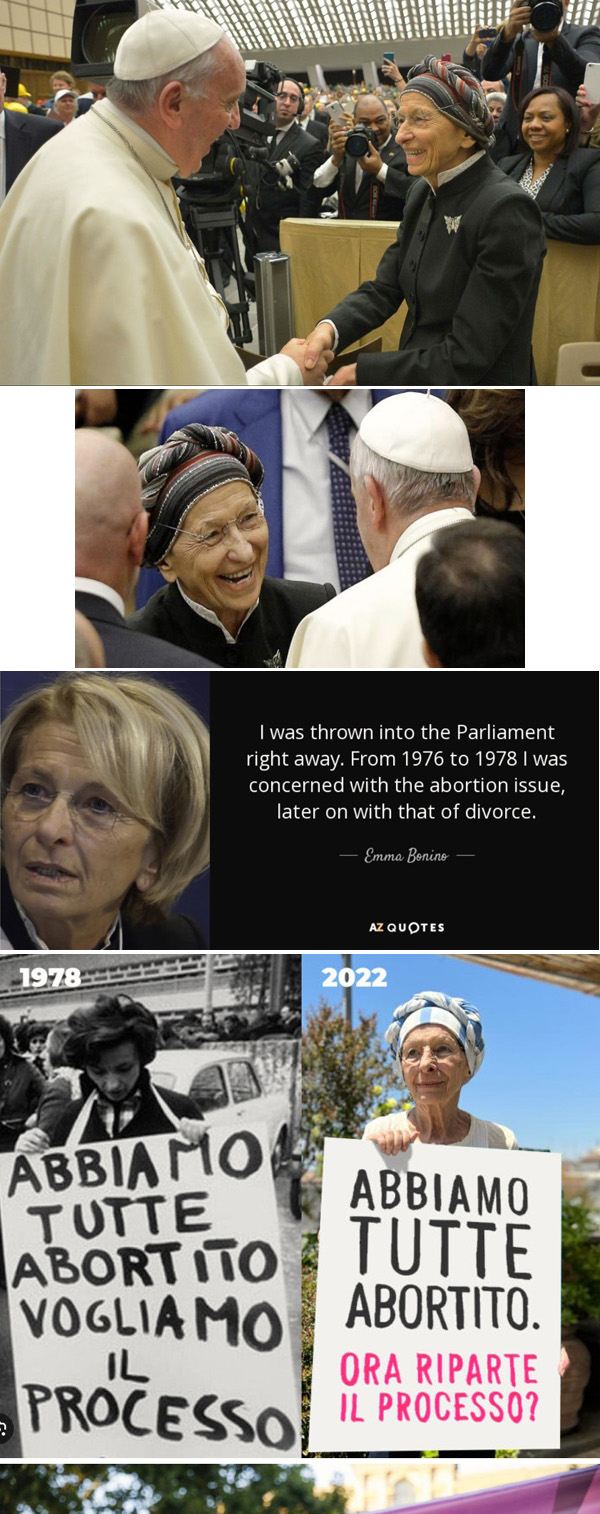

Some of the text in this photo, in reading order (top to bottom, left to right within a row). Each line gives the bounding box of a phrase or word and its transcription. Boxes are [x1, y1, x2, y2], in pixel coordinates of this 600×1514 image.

[8, 1130, 264, 1198] ABBIAMO
[26, 1192, 213, 1244] TUTTE
[349, 1168, 529, 1217] ABBIAMO
[12, 1238, 278, 1290] ABORTITO
[349, 1216, 532, 1280] TUTTE
[20, 1295, 283, 1352] VOGLIAMO
[344, 1283, 541, 1331] ABORTITO.
[107, 1349, 150, 1383] IL
[340, 1352, 539, 1387] ORA RIPARTE
[21, 1383, 297, 1451] PROCESSO
[340, 1391, 539, 1424] IL PROCESSO?
